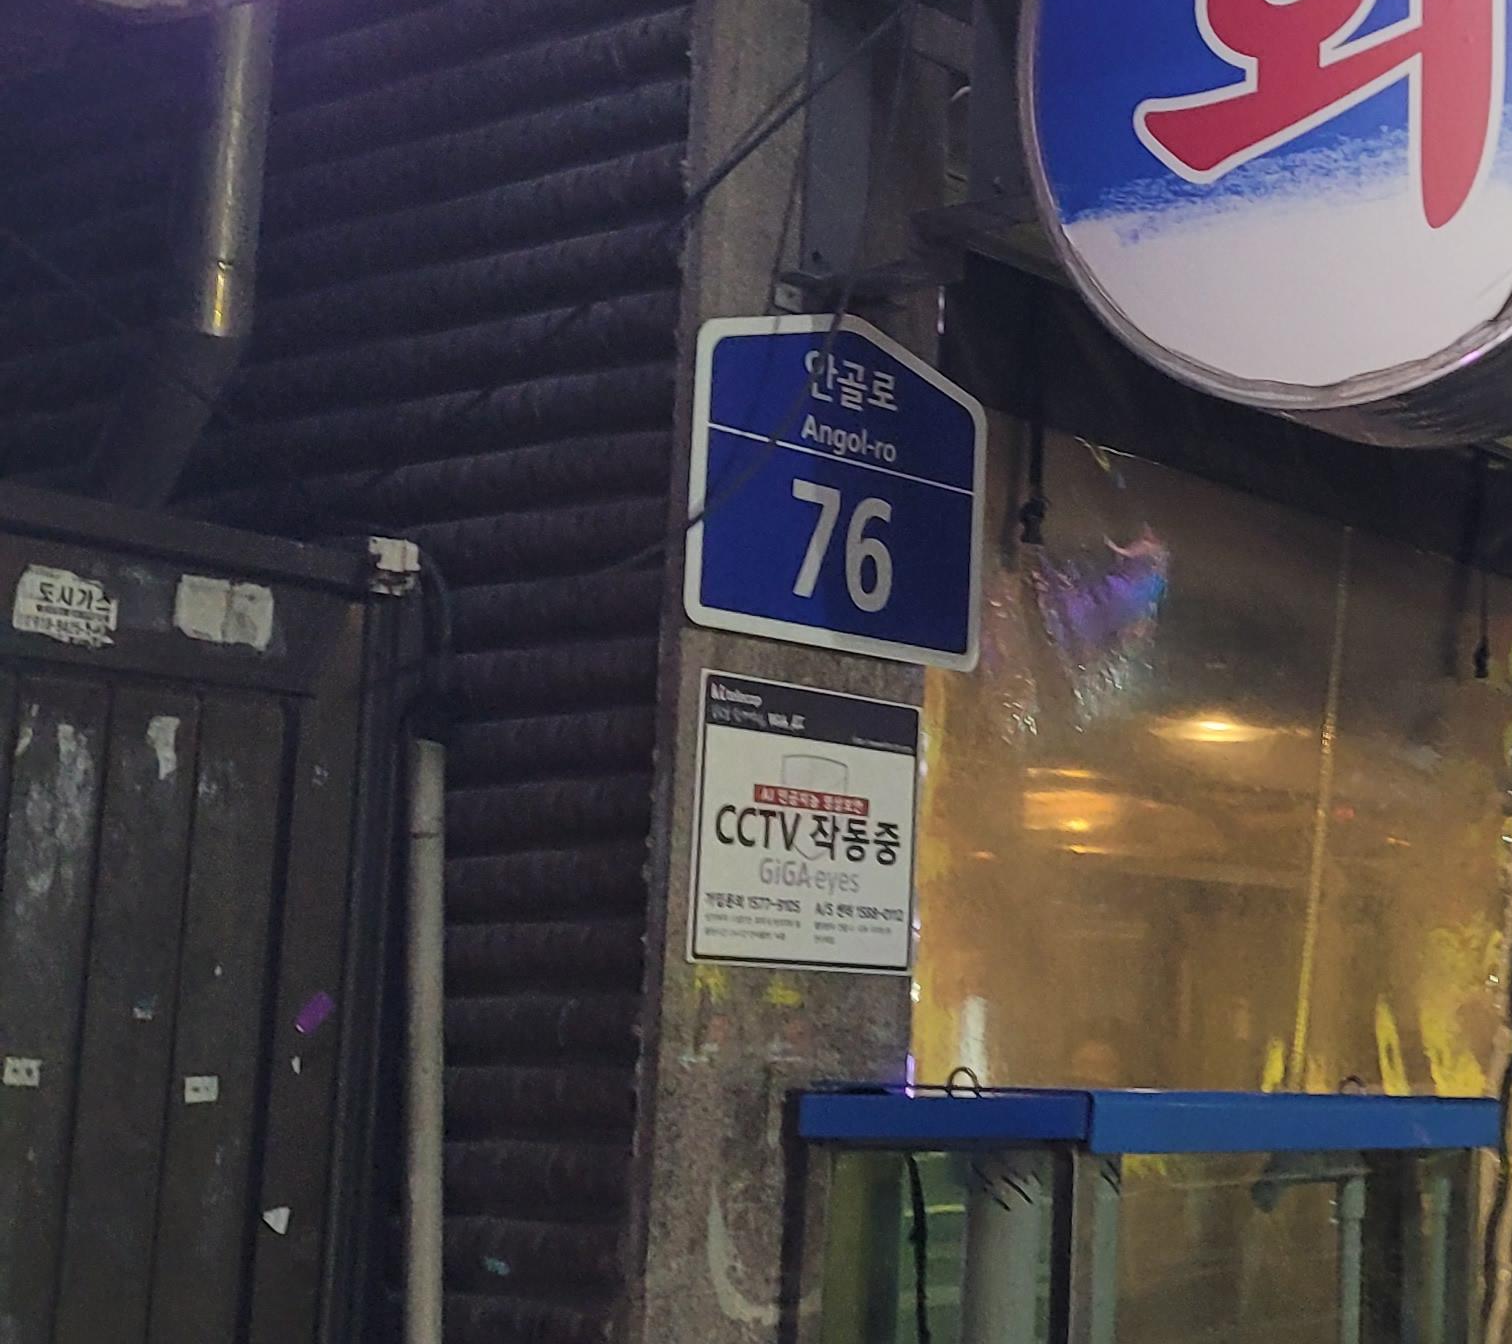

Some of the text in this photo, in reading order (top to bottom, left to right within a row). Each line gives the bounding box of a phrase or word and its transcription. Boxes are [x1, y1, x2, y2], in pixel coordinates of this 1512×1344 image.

[804, 350, 898, 411] 안골로
[801, 414, 897, 462] Angol-ro
[792, 478, 893, 613] 76
[715, 805, 901, 867] CCTV 작동중
[759, 858, 861, 895] GiGA eyes
